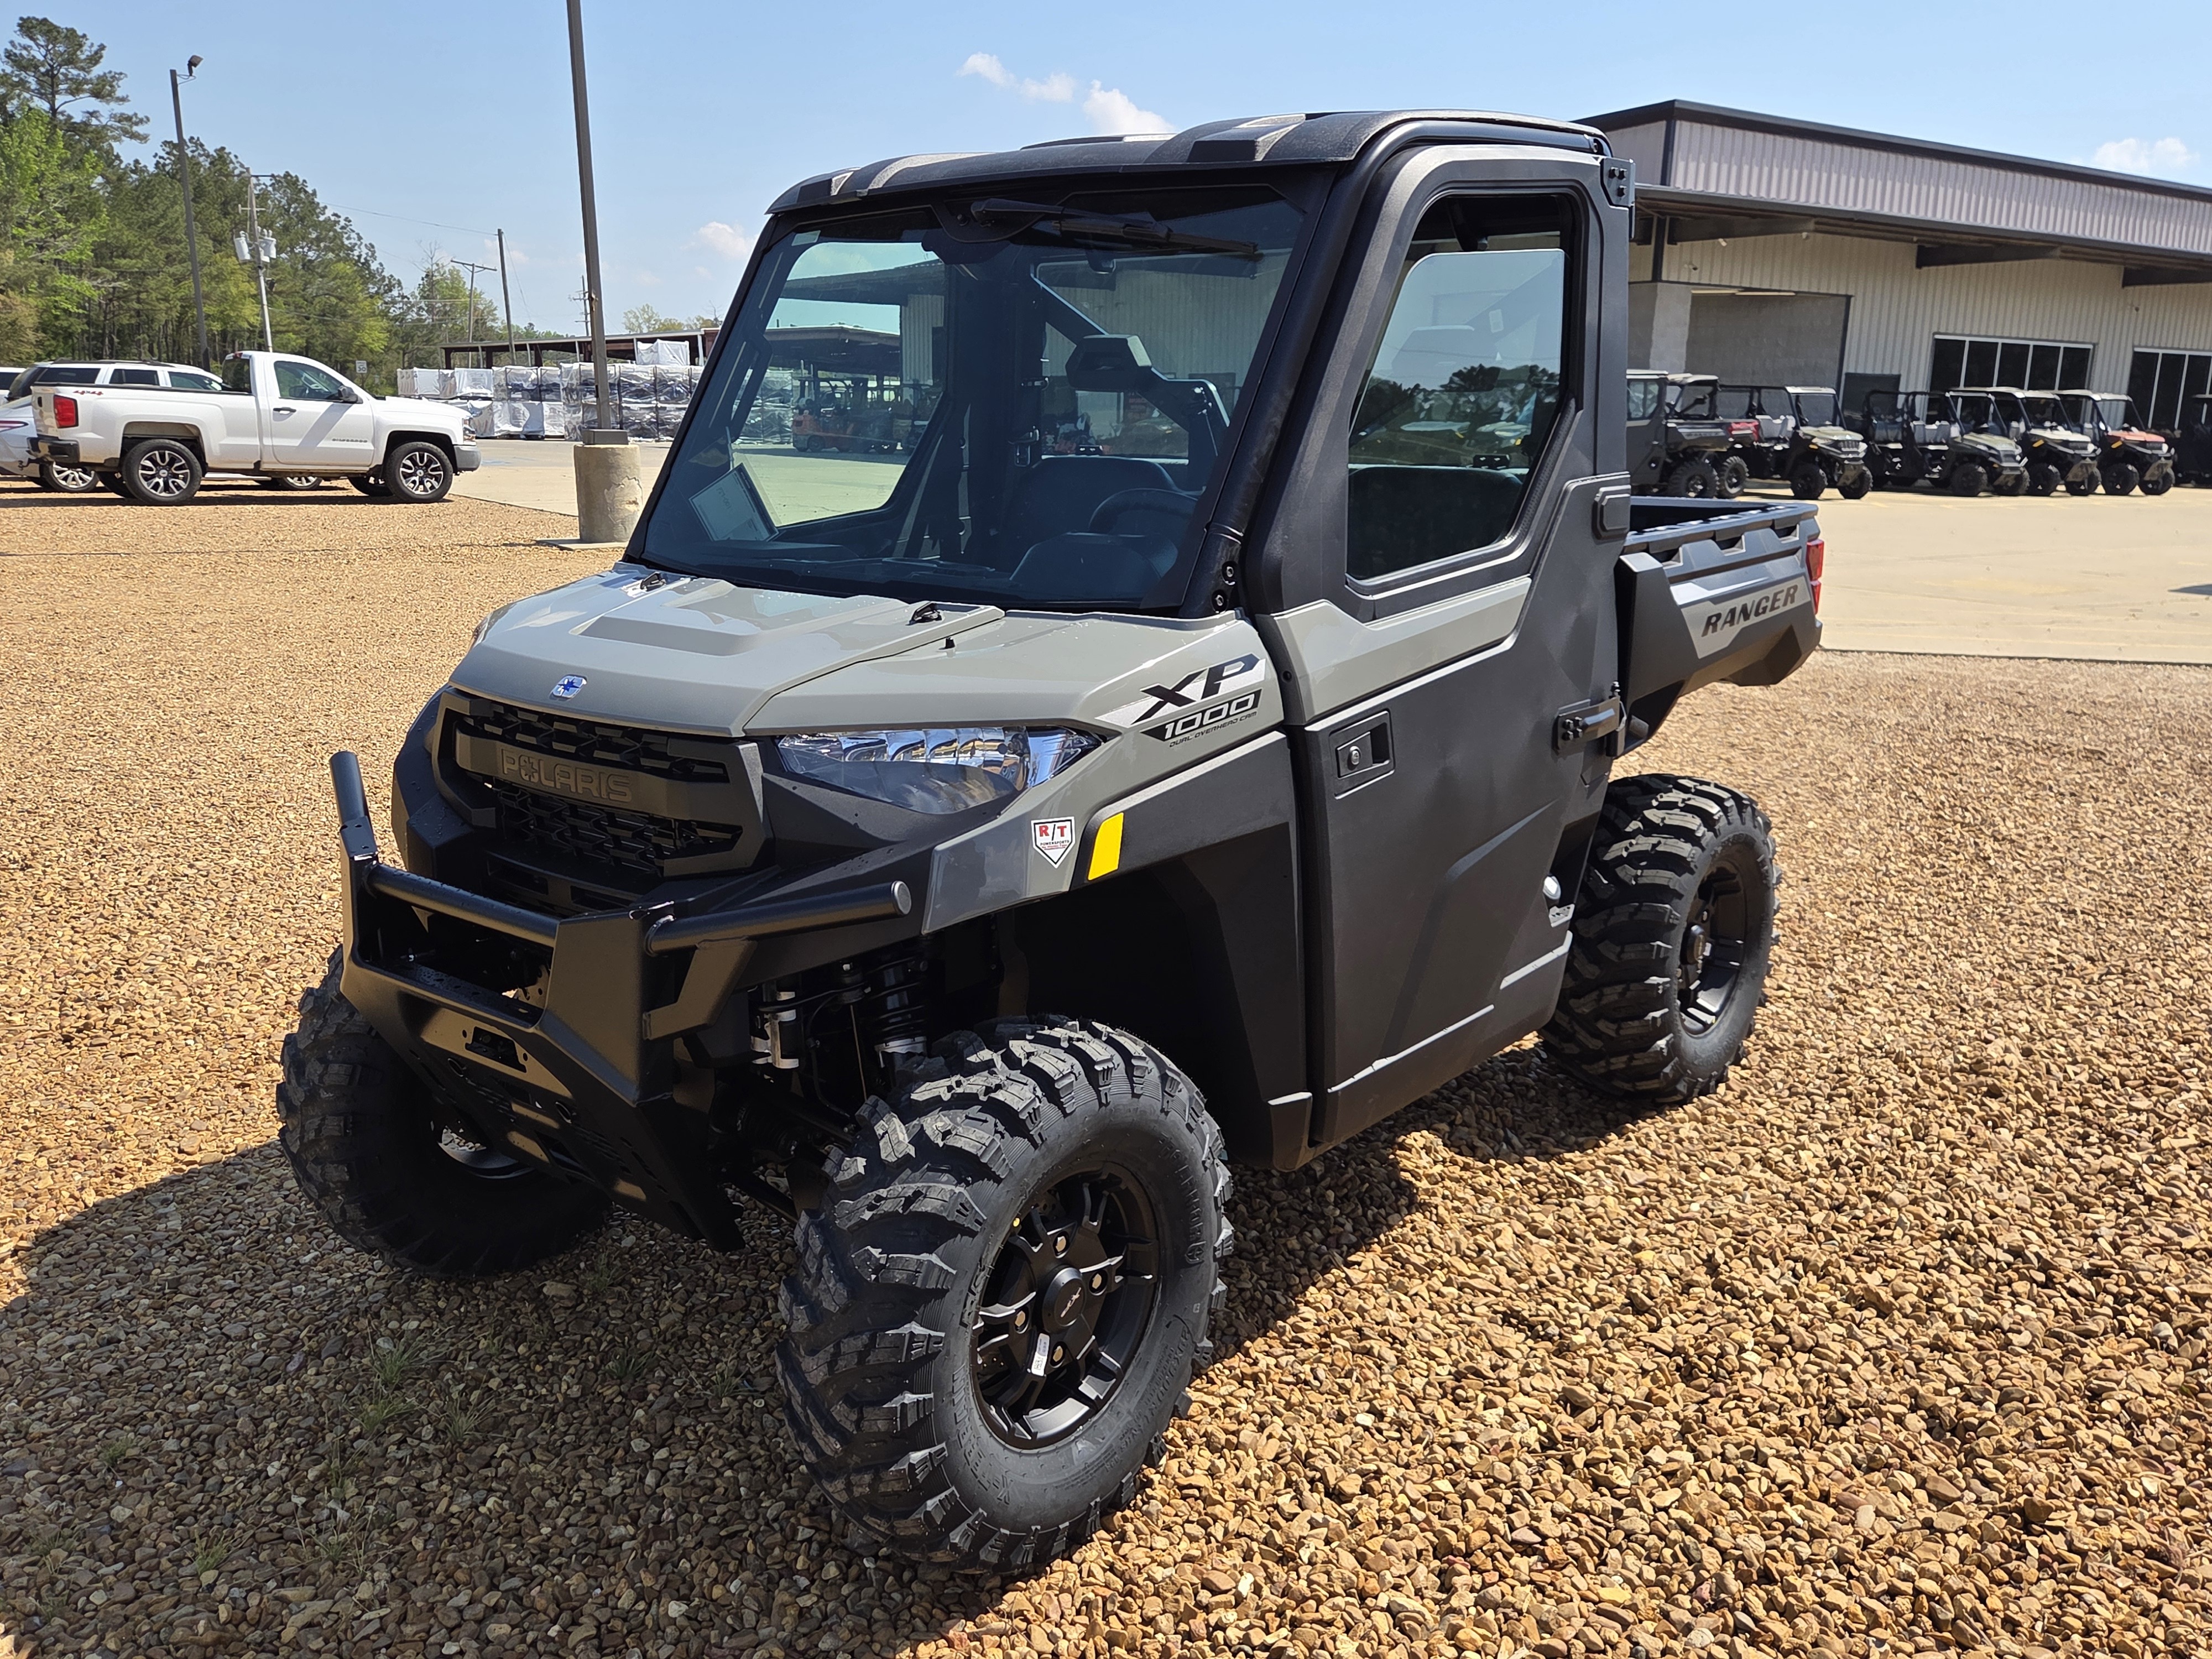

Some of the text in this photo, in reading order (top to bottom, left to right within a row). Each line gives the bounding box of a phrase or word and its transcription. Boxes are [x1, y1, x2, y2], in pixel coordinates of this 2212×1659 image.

[1701, 584, 1798, 638] RANGER
[1130, 653, 1260, 725] XP
[1165, 693, 1255, 739] 1000
[1169, 711, 1257, 747] DUAL OVERHEAD CAM
[501, 748, 632, 802] POLARIS
[1039, 823, 1067, 841] R/T
